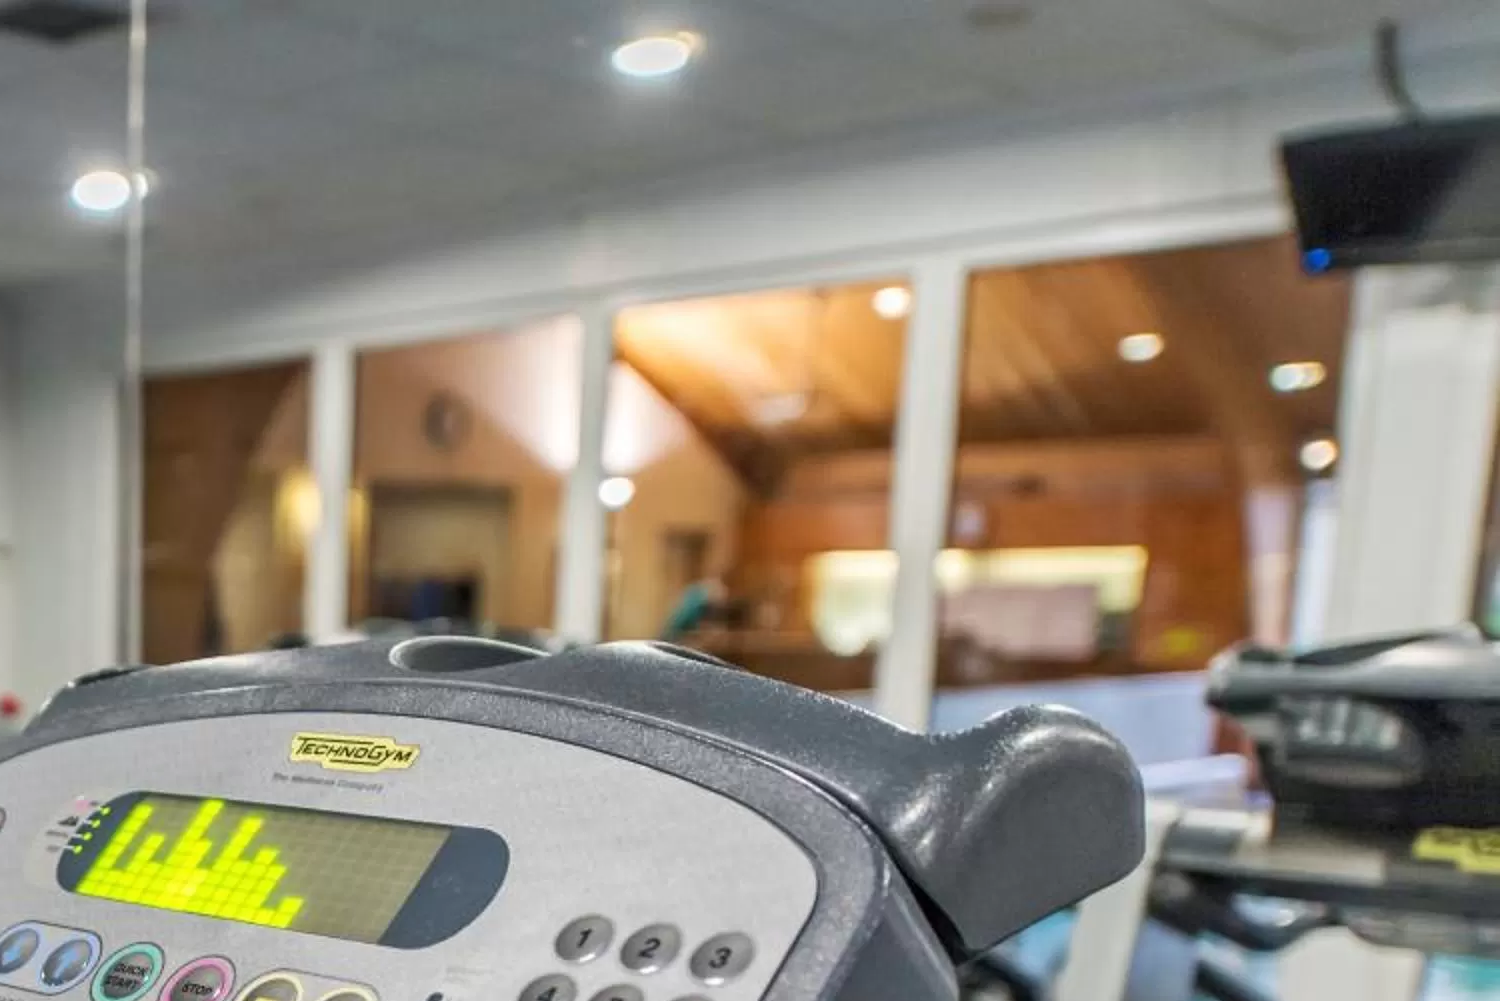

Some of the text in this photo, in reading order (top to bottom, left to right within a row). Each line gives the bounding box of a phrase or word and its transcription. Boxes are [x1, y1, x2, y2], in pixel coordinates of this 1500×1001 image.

[296, 736, 412, 766] TECHNOGYM
[577, 927, 593, 949] 1
[641, 938, 662, 959] 2
[709, 946, 732, 969] 3
[181, 982, 213, 997] STOP
